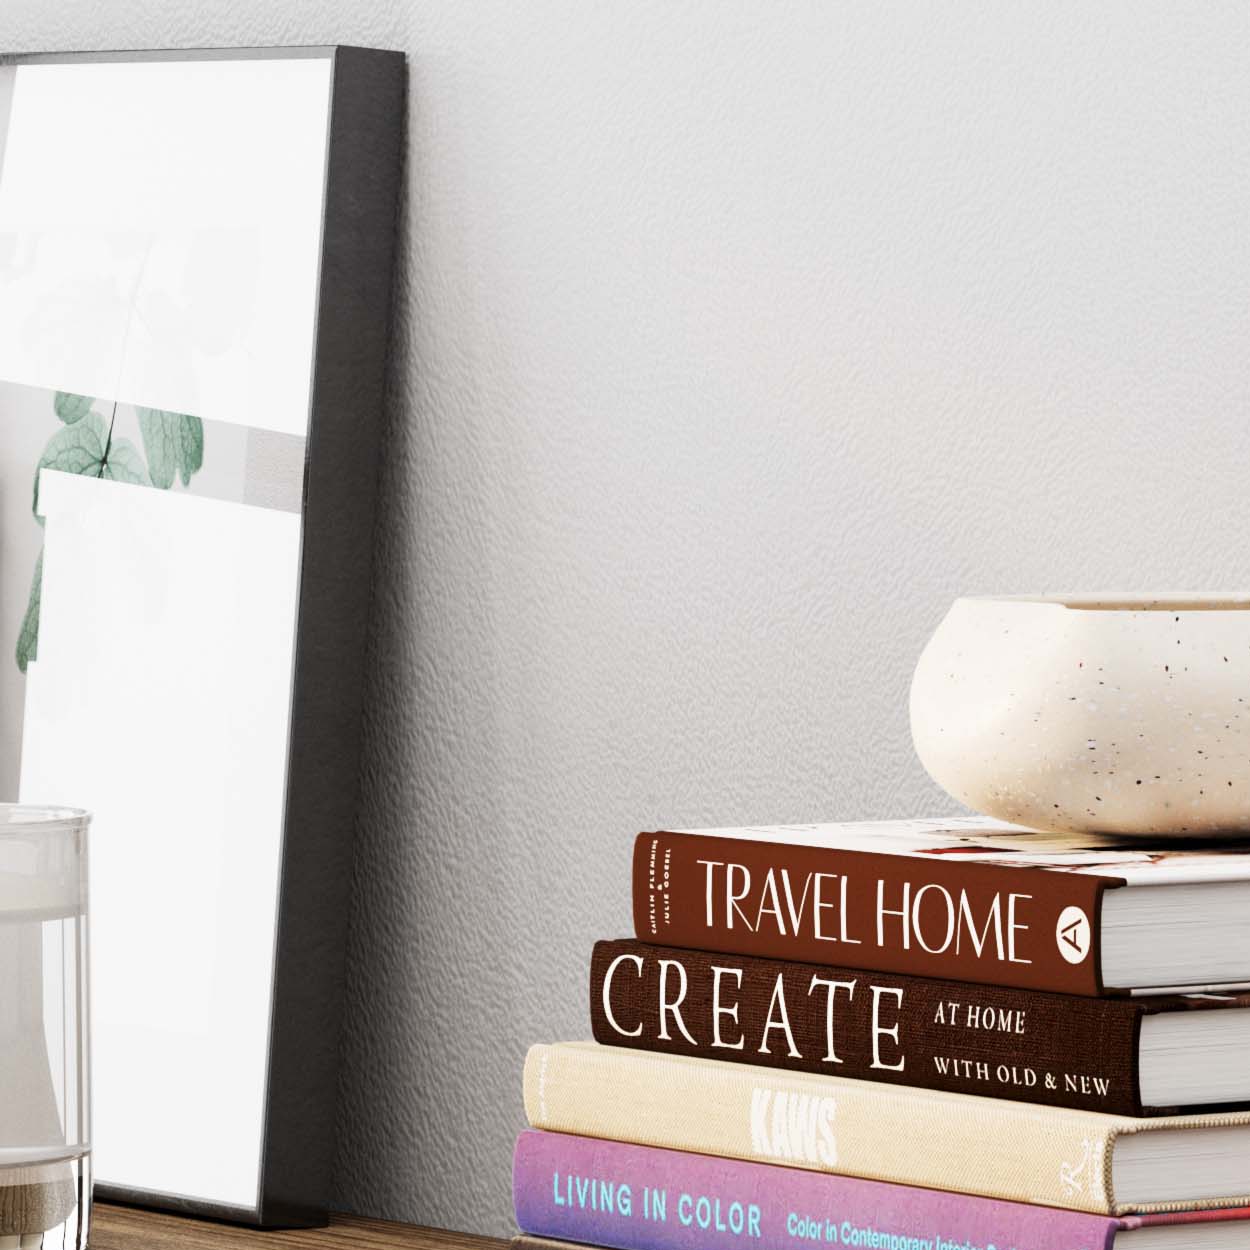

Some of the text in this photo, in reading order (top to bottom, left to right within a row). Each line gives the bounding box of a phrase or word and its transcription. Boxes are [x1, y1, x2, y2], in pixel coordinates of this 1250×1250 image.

[649, 895, 657, 935] CAITLIN
[663, 893, 671, 925] JULIE
[696, 859, 1032, 964] TRAVEL HOME
[602, 954, 905, 1072] CREATE
[934, 1002, 1025, 1034] AT HOME
[934, 1057, 1110, 1096] WITH OLD & NEW
[751, 1087, 838, 1167] KAWS
[553, 1173, 761, 1237] LIVING IN COLOR
[787, 1213, 823, 1240] Color
[825, 1219, 838, 1242] in
